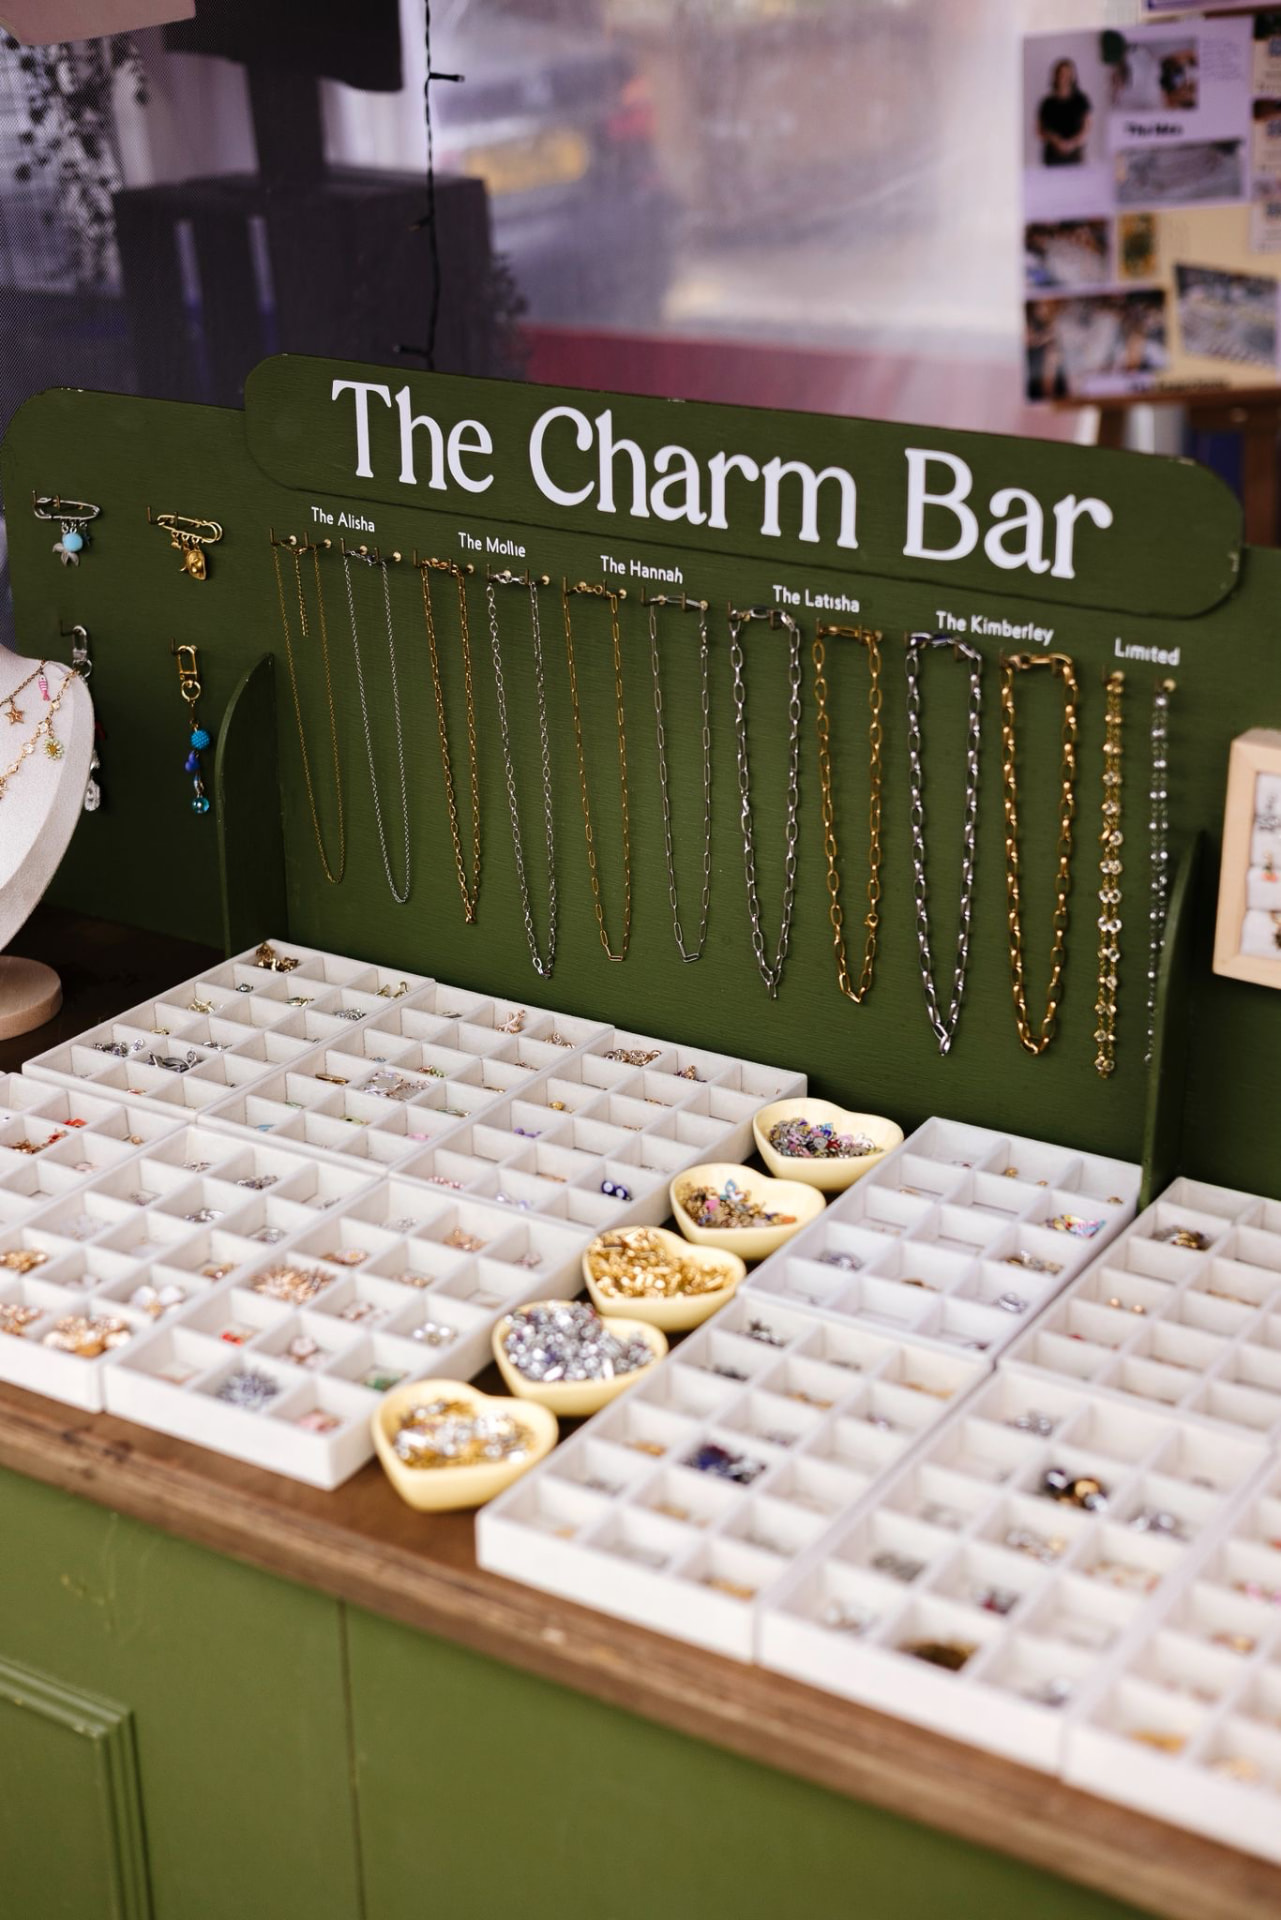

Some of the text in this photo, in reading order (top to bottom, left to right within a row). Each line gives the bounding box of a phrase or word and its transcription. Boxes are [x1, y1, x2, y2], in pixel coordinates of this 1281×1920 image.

[332, 380, 1113, 579] The Charm Bar
[311, 506, 375, 533] The Alisha
[458, 531, 526, 558] The Mollie
[600, 555, 683, 585] The Hannah
[772, 584, 860, 613] The Latisha
[936, 610, 1054, 646] The Kimberley
[1115, 638, 1180, 666] Limited
